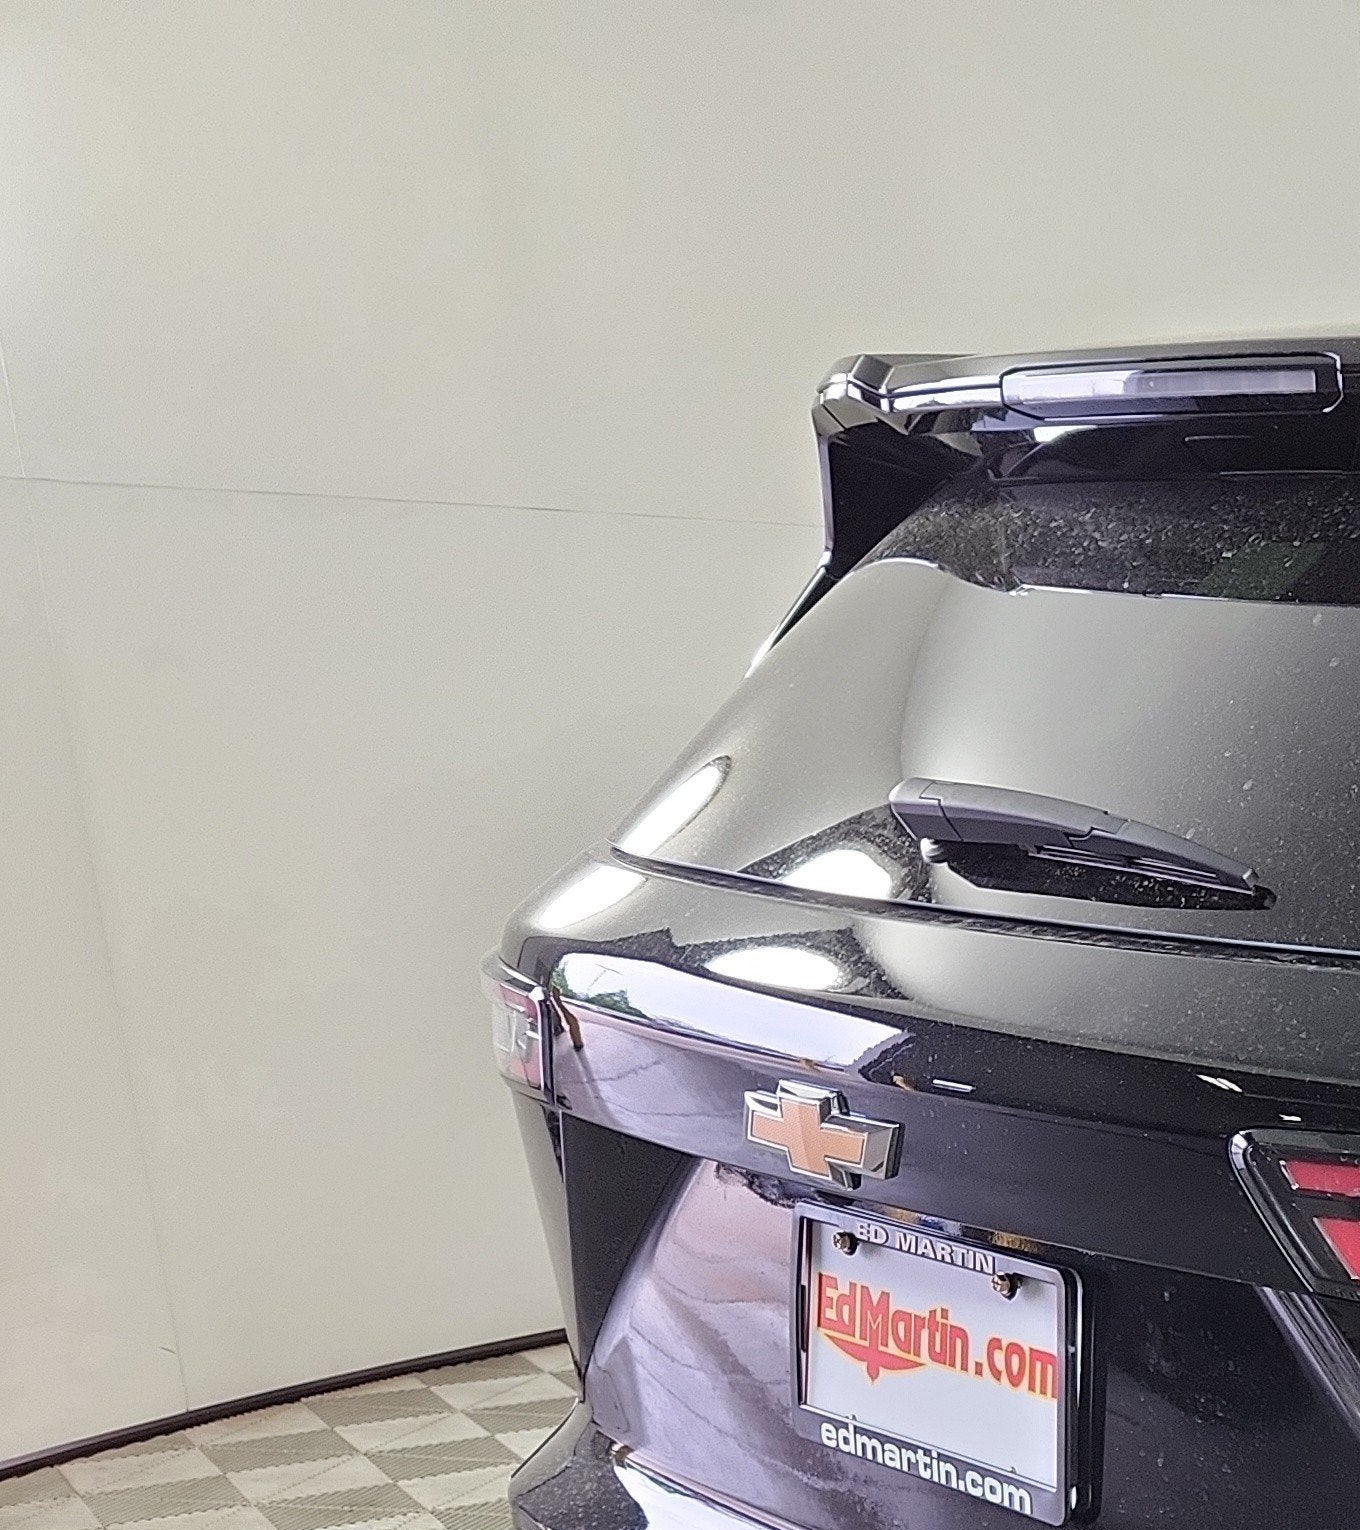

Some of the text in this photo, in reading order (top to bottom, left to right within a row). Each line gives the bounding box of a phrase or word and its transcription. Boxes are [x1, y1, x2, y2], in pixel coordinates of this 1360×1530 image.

[856, 1223, 997, 1275] ED MARTIN
[820, 1420, 1033, 1516] edmartin.com
